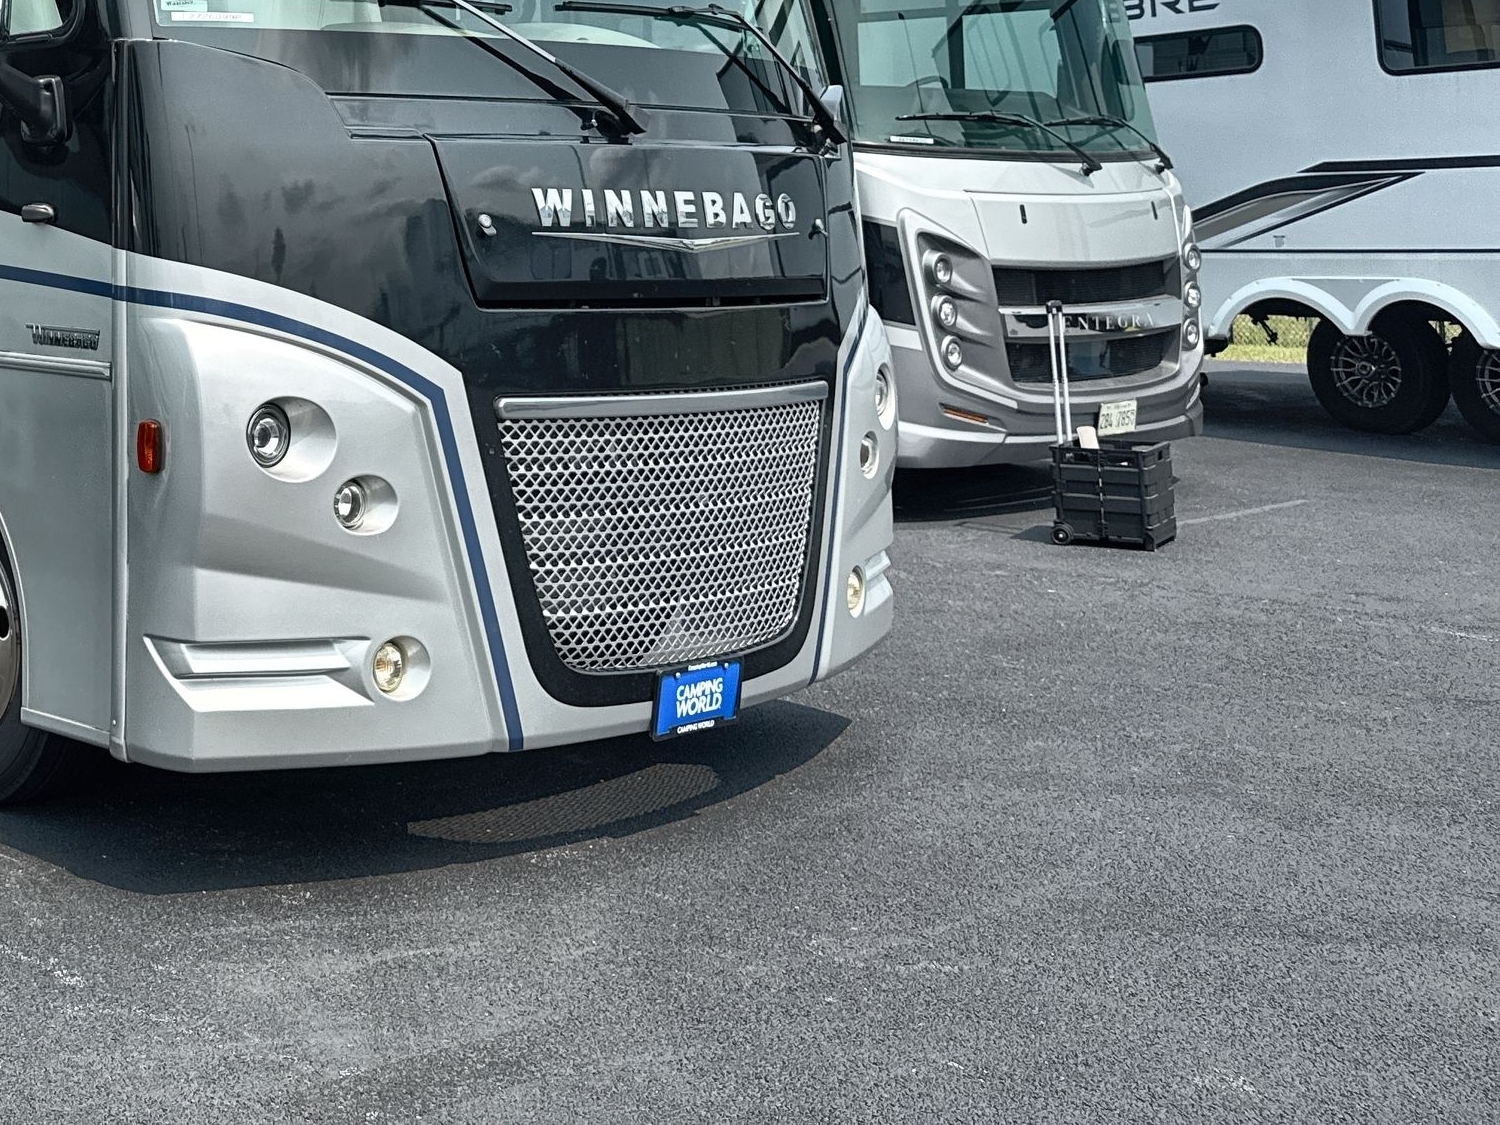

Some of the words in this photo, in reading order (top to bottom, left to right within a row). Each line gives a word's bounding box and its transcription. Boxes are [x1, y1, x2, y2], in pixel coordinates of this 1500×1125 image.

[530, 187, 798, 231] WINNEBAGO
[1062, 312, 1155, 331] ENTEGRA
[676, 677, 724, 702] CAMPING
[675, 692, 723, 719] WORLD
[676, 722, 698, 735] CAMPING
[697, 719, 715, 730] WORLD
